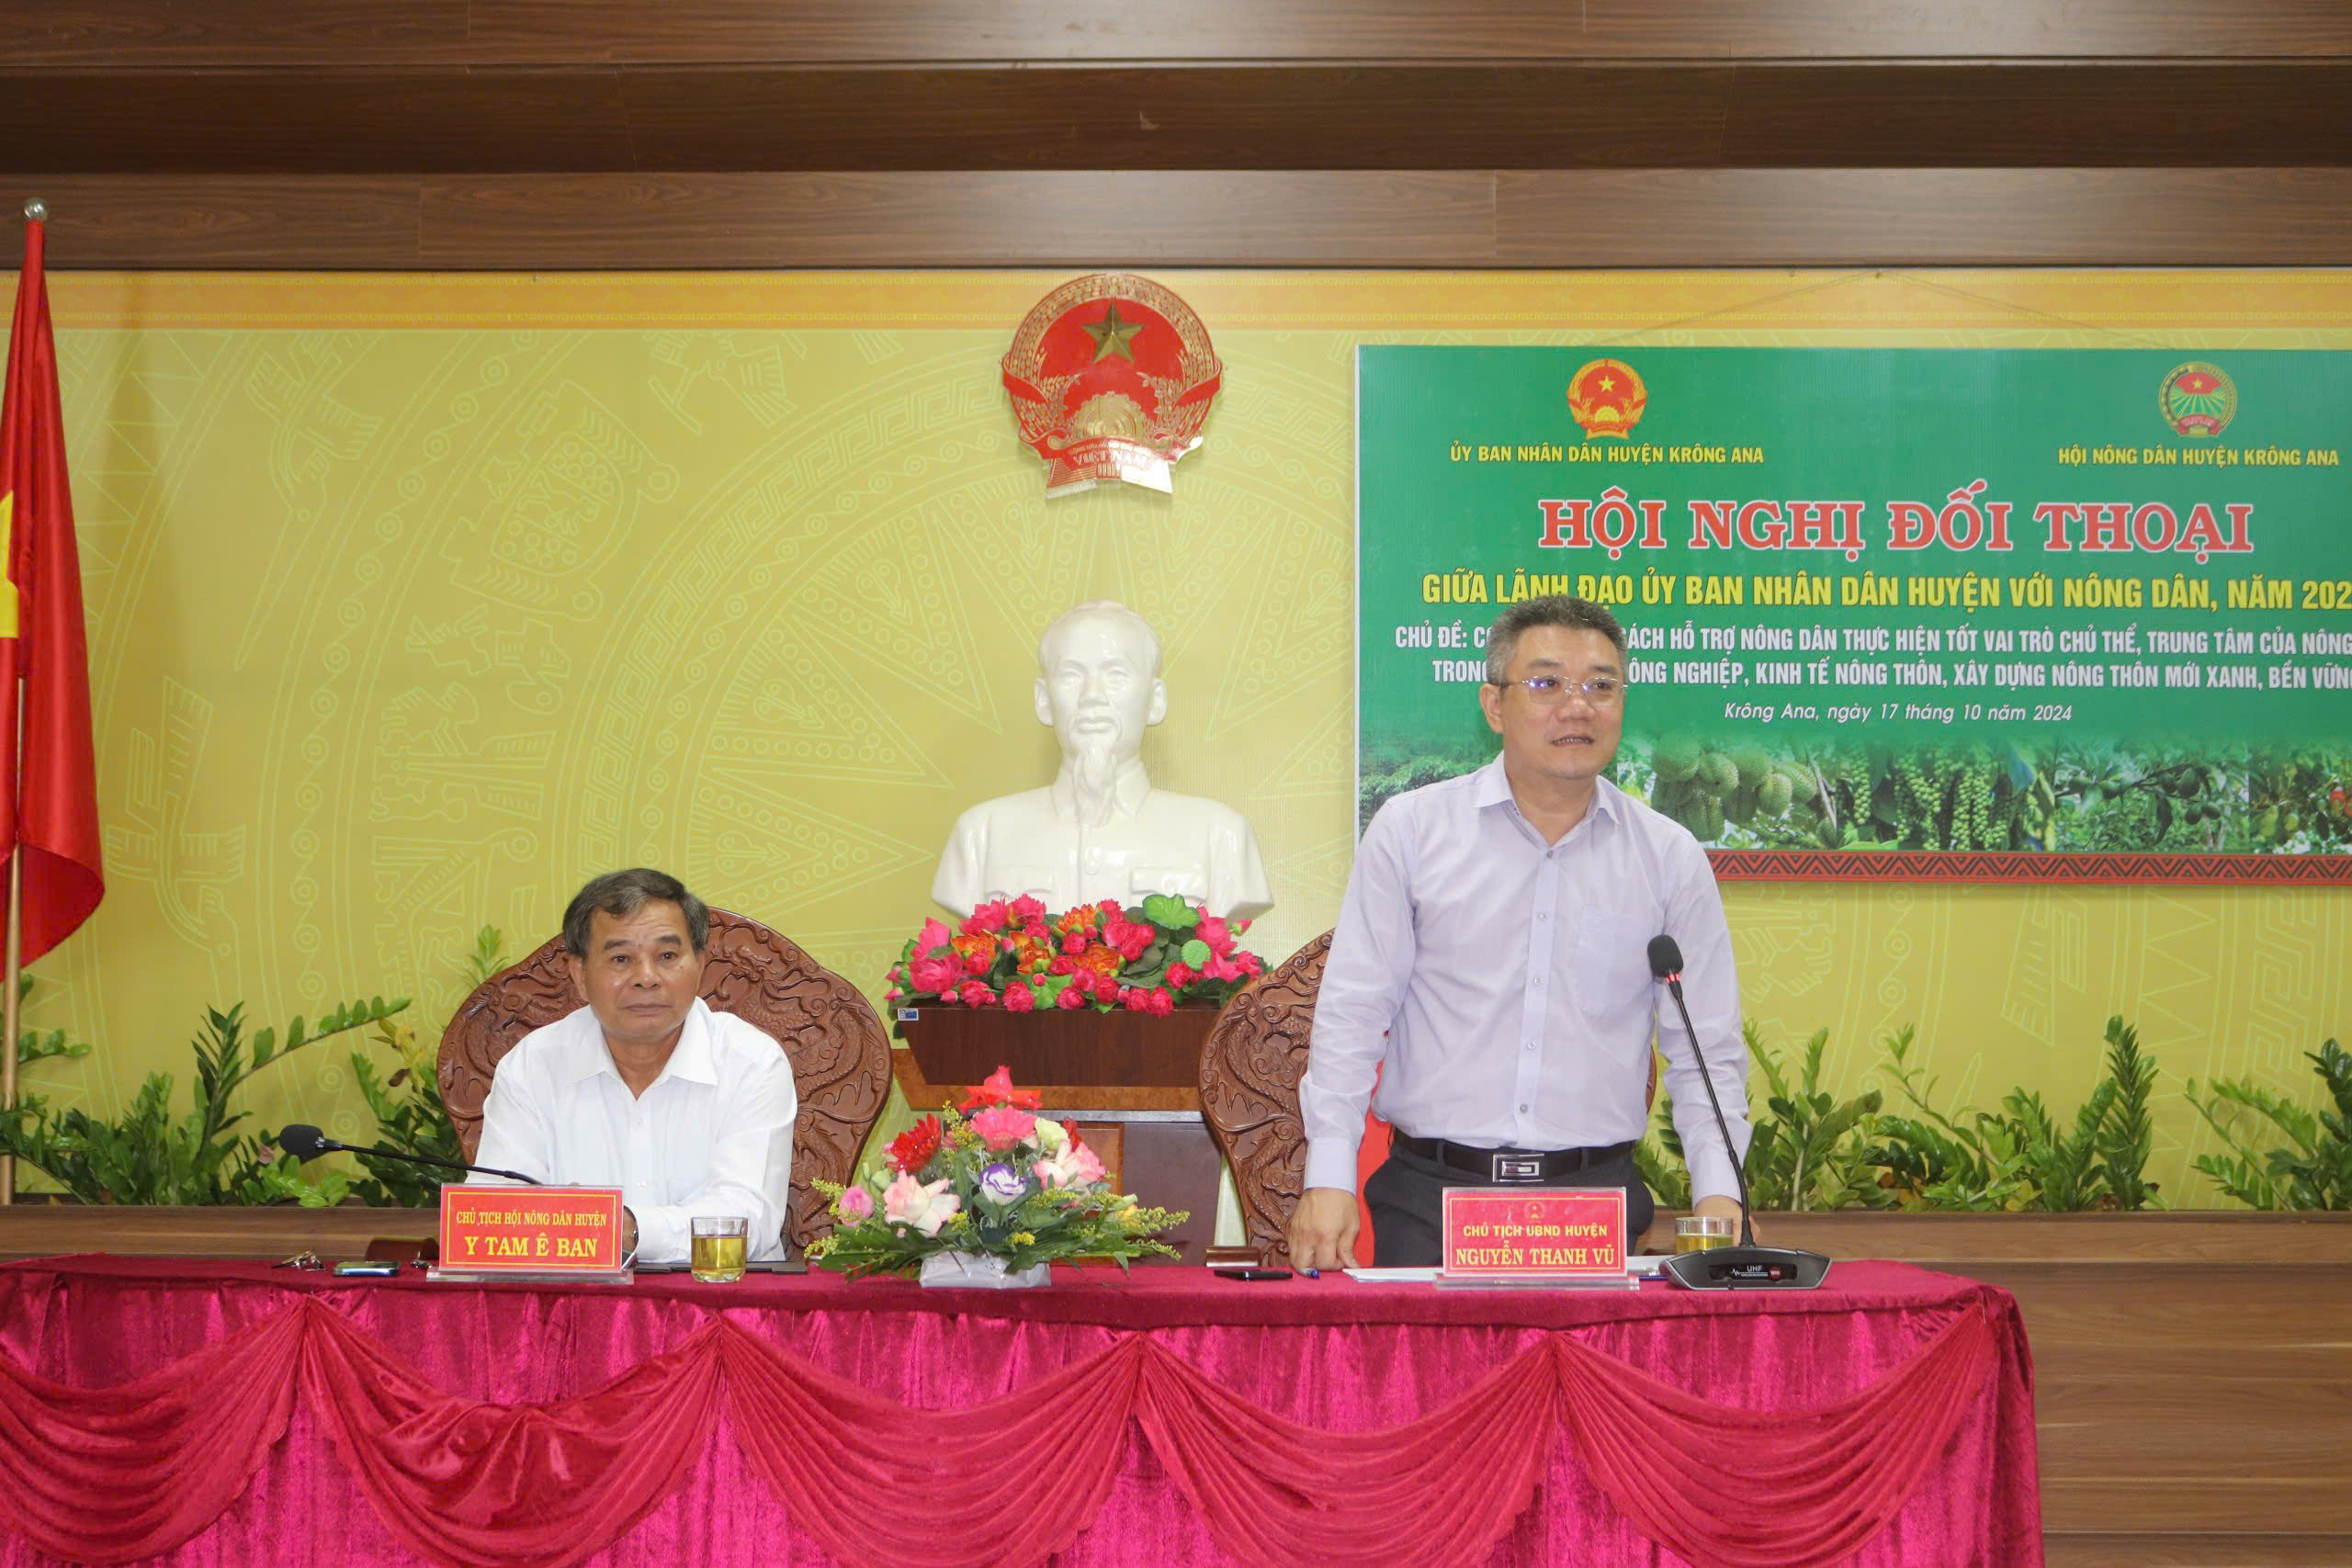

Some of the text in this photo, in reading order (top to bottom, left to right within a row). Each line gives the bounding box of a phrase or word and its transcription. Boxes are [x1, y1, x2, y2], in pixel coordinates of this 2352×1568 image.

[1451, 440, 1764, 466] ỦY BAN NHÂN DÂN HUYỆN KRÔNG ANA
[2058, 443, 2338, 470] HỘI NÔNG DÂN HUYỆN KRÔNG ANA
[1537, 477, 2255, 567] HỘI NGHỊ ĐỐI THOẠI
[1422, 567, 2352, 613] GIỮA LÃNH ĐẠO ỦY BAN NHÂN DÂN HUYỆN VỚI NÔNG DÂN, NĂM 202
[1395, 618, 2352, 657] CHỦ ĐỀ: C ÁCH HỖ TRỢ NÔNG DÂN THỰC HIỆN TỐT VAI TRÒ CHỦ THỂ, TRUNG TÂM CỦA NÔNG
[1627, 657, 1668, 684] ÔNG
[1673, 657, 1749, 689] NGHIỆP,
[1756, 661, 1802, 684] KINH
[1806, 655, 1831, 685] TẾ
[1835, 658, 1888, 685] NÔNG
[1893, 659, 1948, 689] THÔN,
[1953, 659, 1989, 686] XÂY
[1995, 660, 2046, 692] DỰNG
[2052, 660, 2105, 687] NÔNG
[2109, 660, 2159, 688] THÔN
[2165, 660, 2200, 688] MỚI
[2206, 665, 2263, 691] XANH,
[2312, 662, 2352, 689] VỮN
[1724, 702, 2073, 725] Krông Ana, ngày 17 tháng 10 năm 2024
[456, 1206, 476, 1224] CHỦ
[503, 1209, 522, 1228] HỘI
[523, 1209, 550, 1226] NÔNG
[552, 1210, 572, 1226] DÂN
[1463, 1221, 1489, 1237] CHỦ
[1492, 1224, 1524, 1239] TỊCH
[1565, 1222, 1608, 1238] HUYỆN
[464, 1232, 598, 1258] Y TAM Ê BAN
[1455, 1239, 1615, 1266] NGUYỄN THANH VŨ
